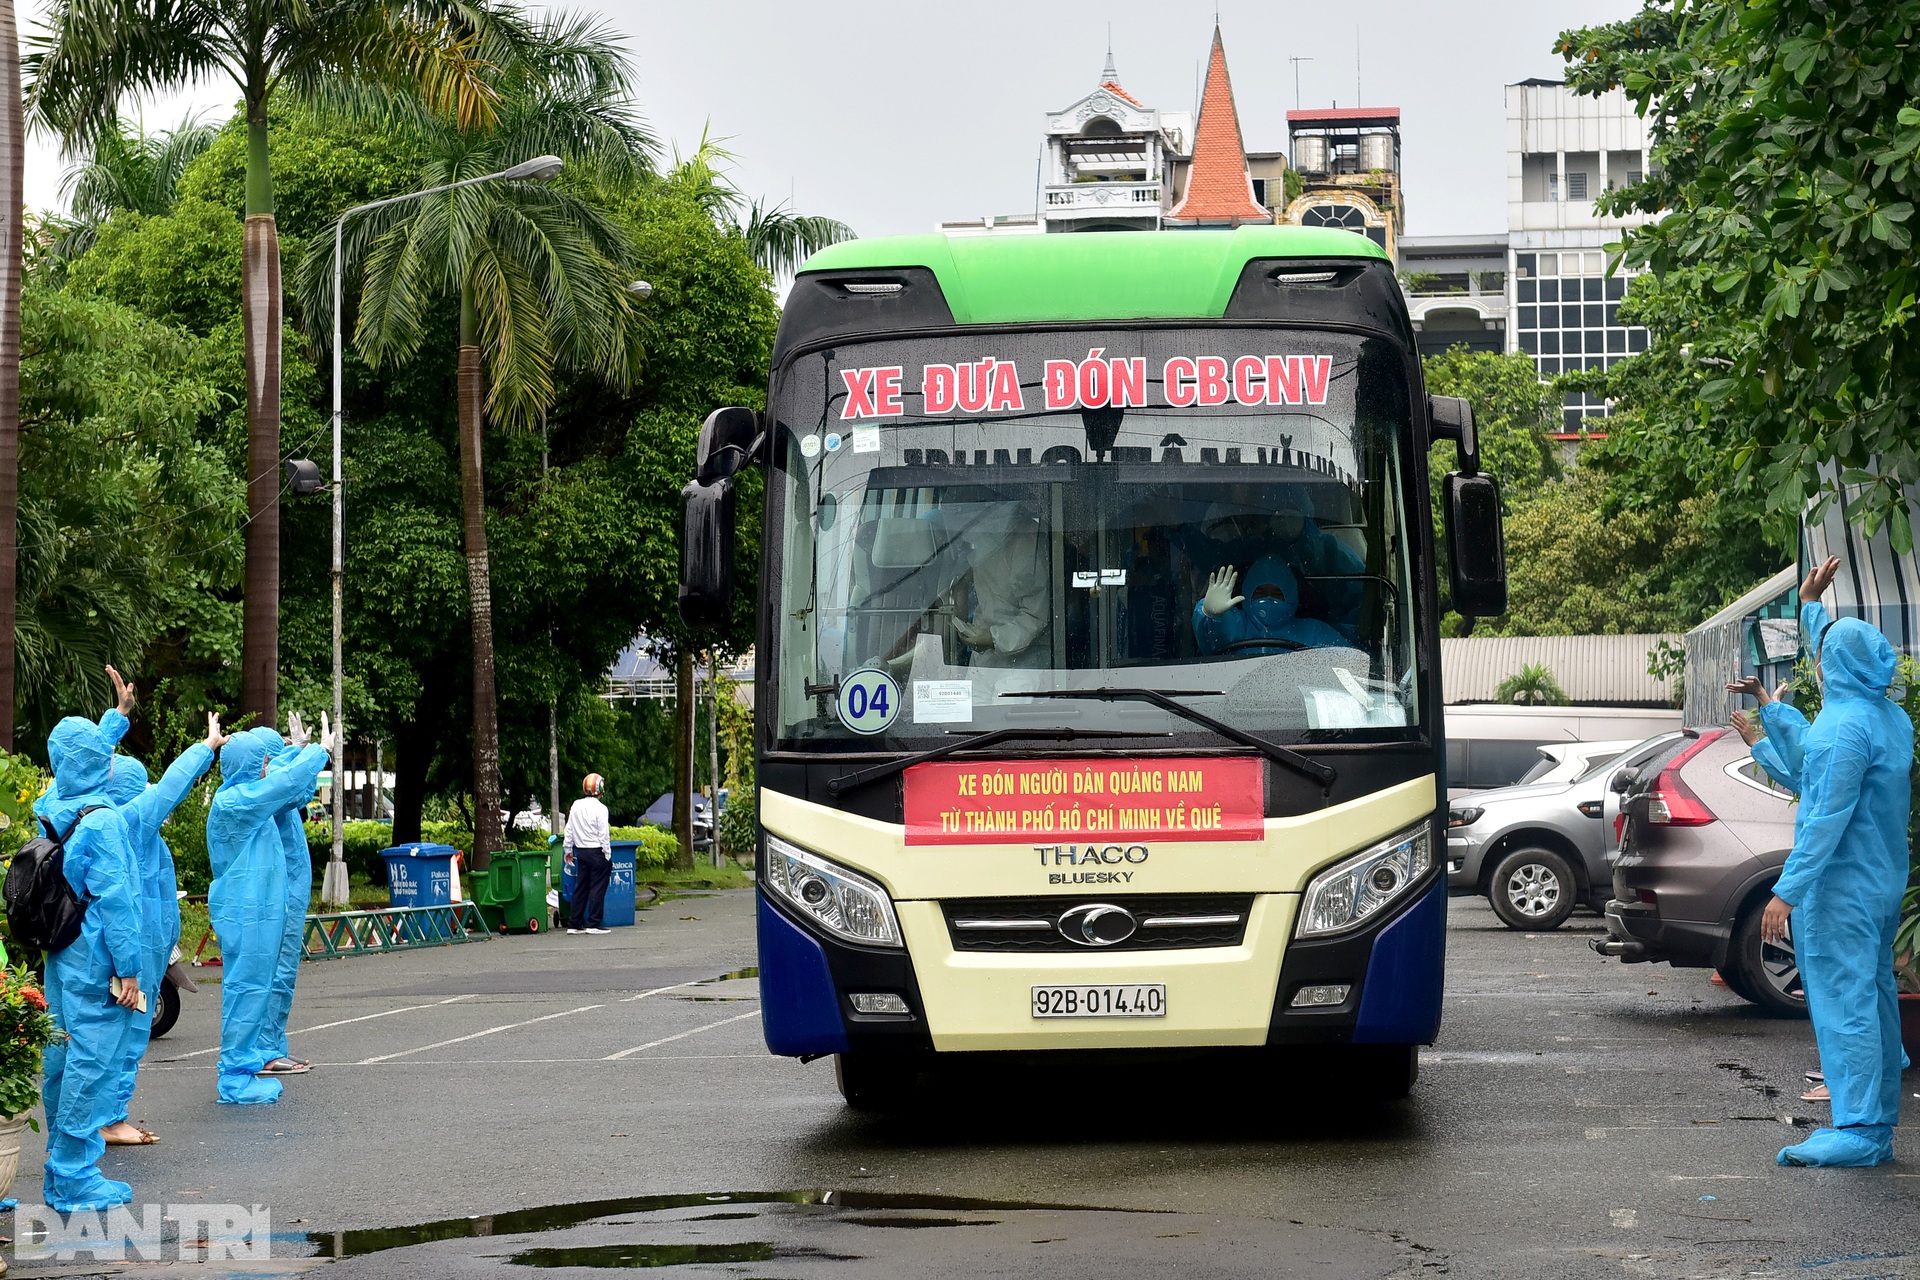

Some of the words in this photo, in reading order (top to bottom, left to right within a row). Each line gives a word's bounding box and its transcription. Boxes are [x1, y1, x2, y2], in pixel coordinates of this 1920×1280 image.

[840, 366, 903, 419] XE
[922, 357, 1025, 414] ĐƯA
[1043, 348, 1147, 410] ĐÓN
[1163, 355, 1333, 408] CBCNV
[1150, 595, 1168, 657] AQUAFINA
[848, 684, 889, 719] 04
[958, 774, 977, 796] XE
[981, 768, 1014, 796] ĐÓN
[1020, 767, 1068, 795] NGƯỜI
[1073, 766, 1104, 794] DÂN
[1109, 765, 1162, 796] QUẢNG
[1168, 771, 1203, 793] NAM
[940, 806, 961, 833] TỪ
[964, 805, 1017, 832] THÀNH
[1022, 801, 1055, 831] PHỐ
[1059, 801, 1081, 831] HỒ
[1086, 803, 1114, 831] CHÍ
[1119, 807, 1161, 830] MINH
[1165, 800, 1186, 830] VỀ
[1190, 802, 1222, 832] QUÊ
[1033, 843, 1149, 866] THACO
[431, 871, 450, 879] Paloca
[1048, 871, 1135, 885] BLUESKY
[1037, 988, 1160, 1014] 92B-014.40
